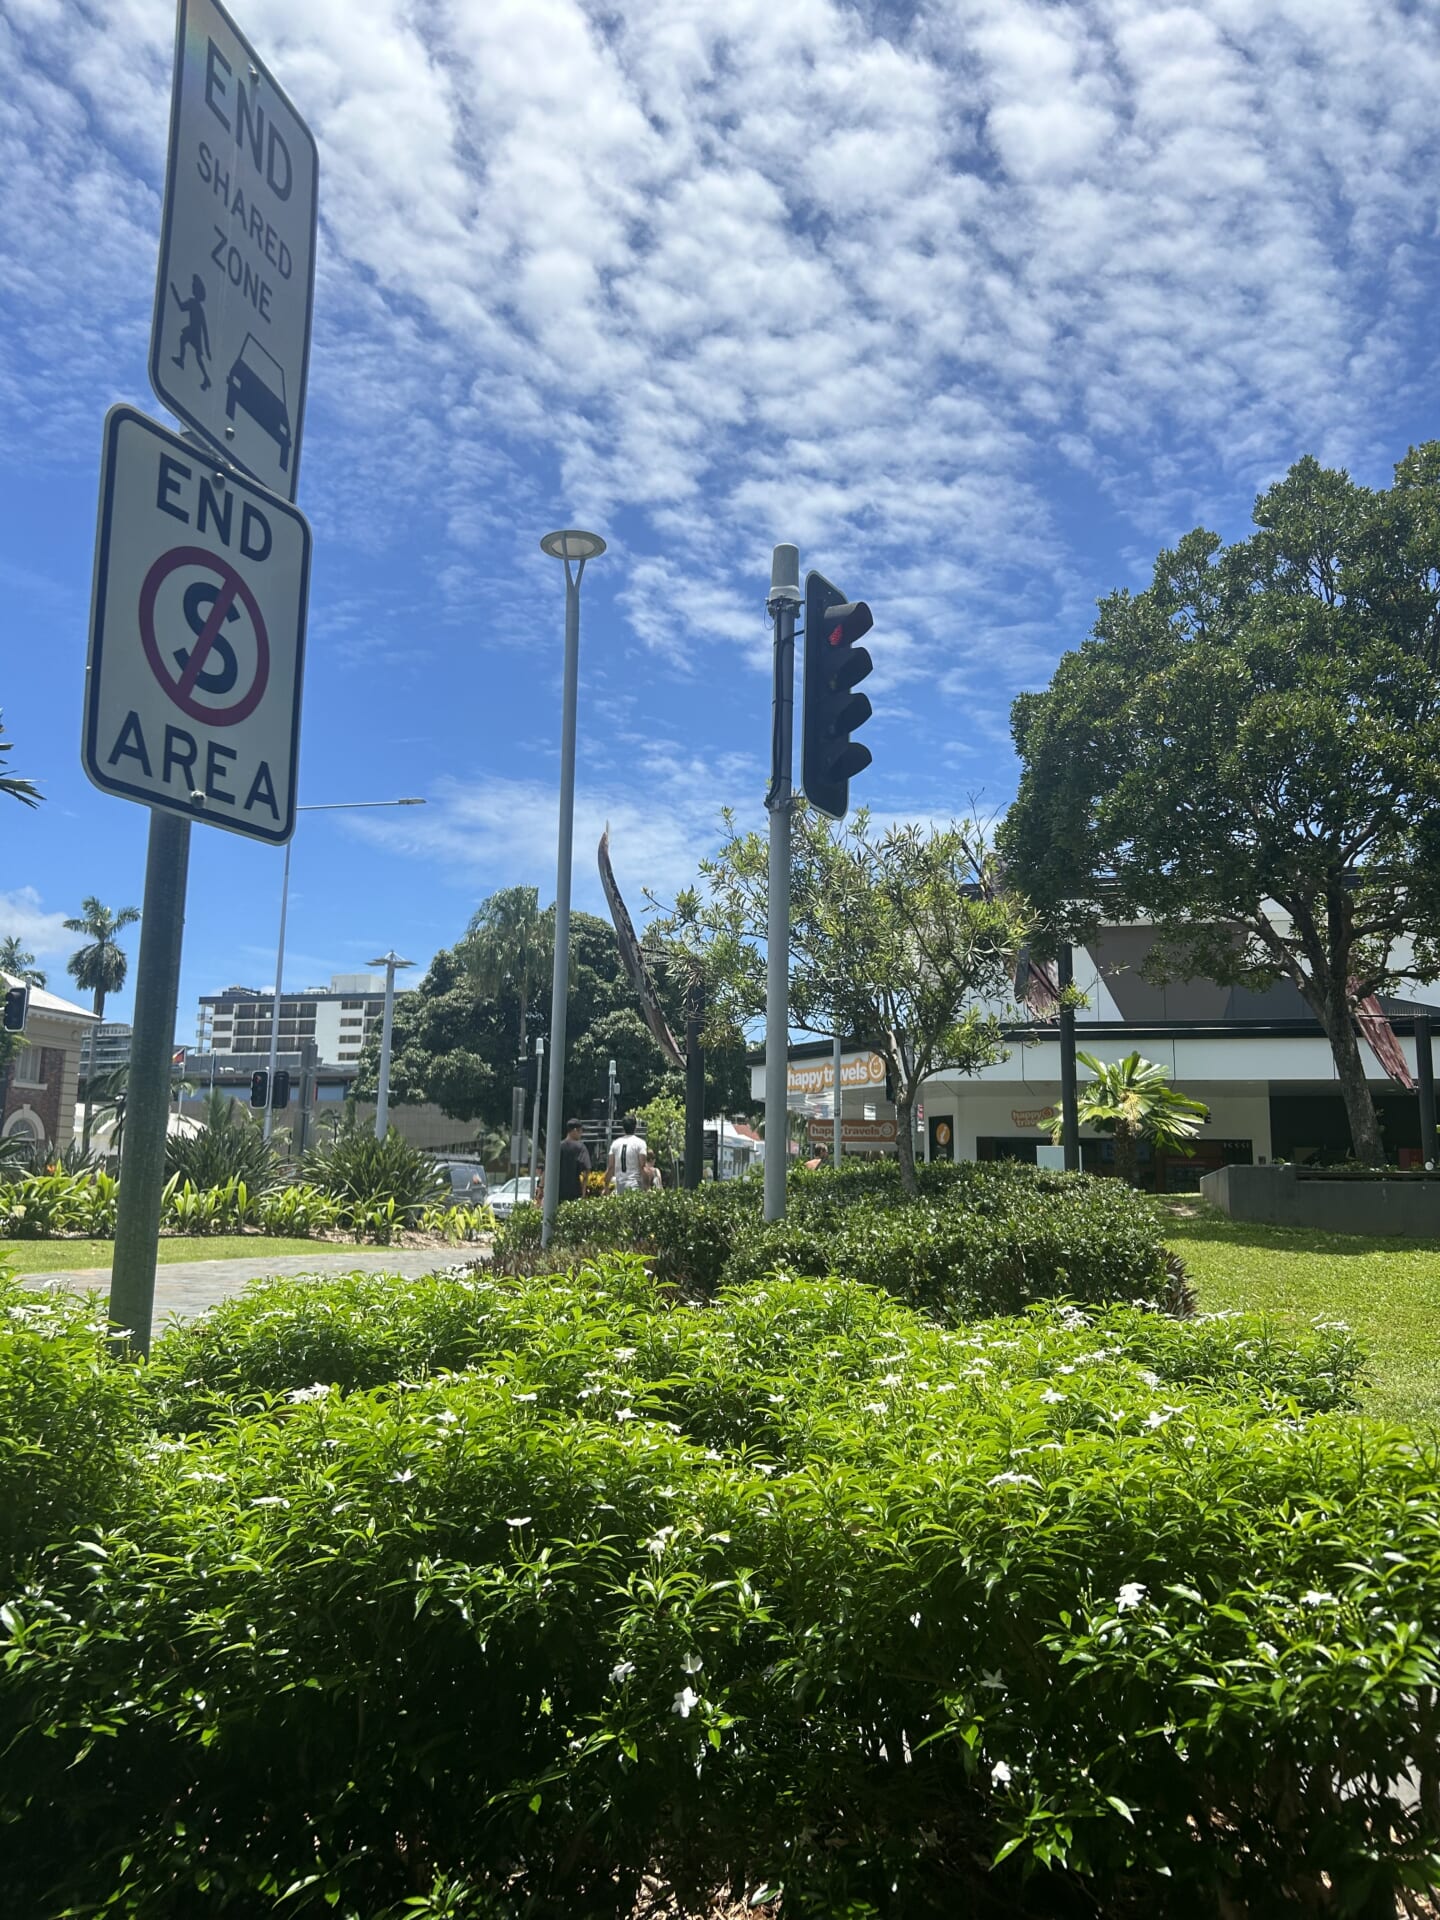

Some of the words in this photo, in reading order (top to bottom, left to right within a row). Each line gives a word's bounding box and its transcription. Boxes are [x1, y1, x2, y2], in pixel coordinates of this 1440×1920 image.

[204, 36, 292, 202] END
[196, 142, 292, 280] SHARED
[211, 224, 273, 324] ZONE
[156, 452, 272, 562] END
[107, 710, 281, 821] AREA
[787, 1068, 822, 1089] happy
[824, 1062, 867, 1083] trvels
[844, 1125, 880, 1136] travels
